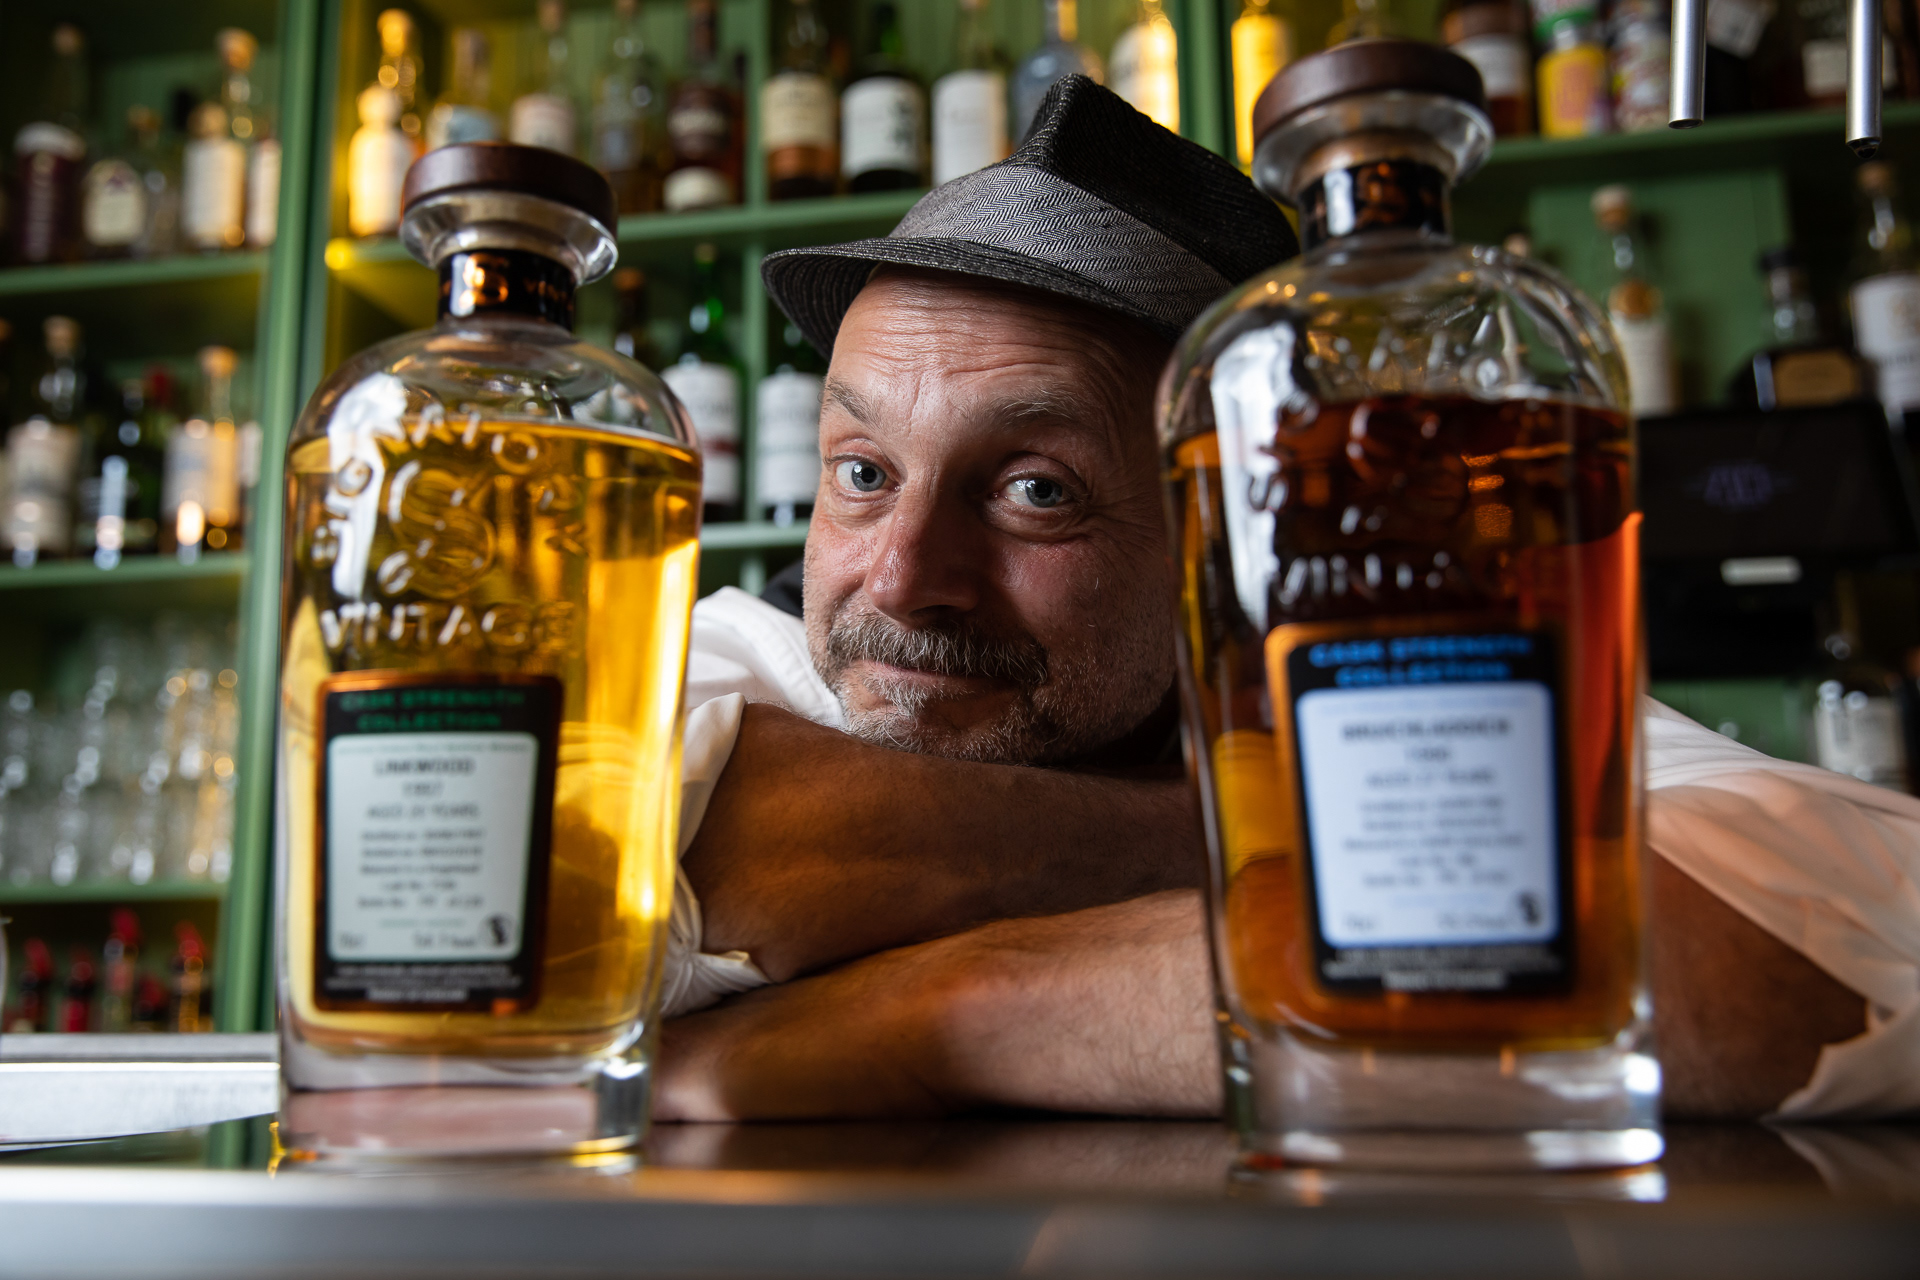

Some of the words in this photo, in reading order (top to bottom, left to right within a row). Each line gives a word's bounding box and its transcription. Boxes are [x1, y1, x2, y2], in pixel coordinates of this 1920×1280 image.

[1311, 641, 1384, 666] CASK
[1391, 637, 1532, 660] STRENGTH
[1337, 663, 1510, 686] COLLECTION
[340, 692, 394, 707] CASK
[402, 690, 526, 706] STRENGTH
[358, 714, 501, 729] COLLECTION
[375, 757, 474, 775] LINKWOOD
